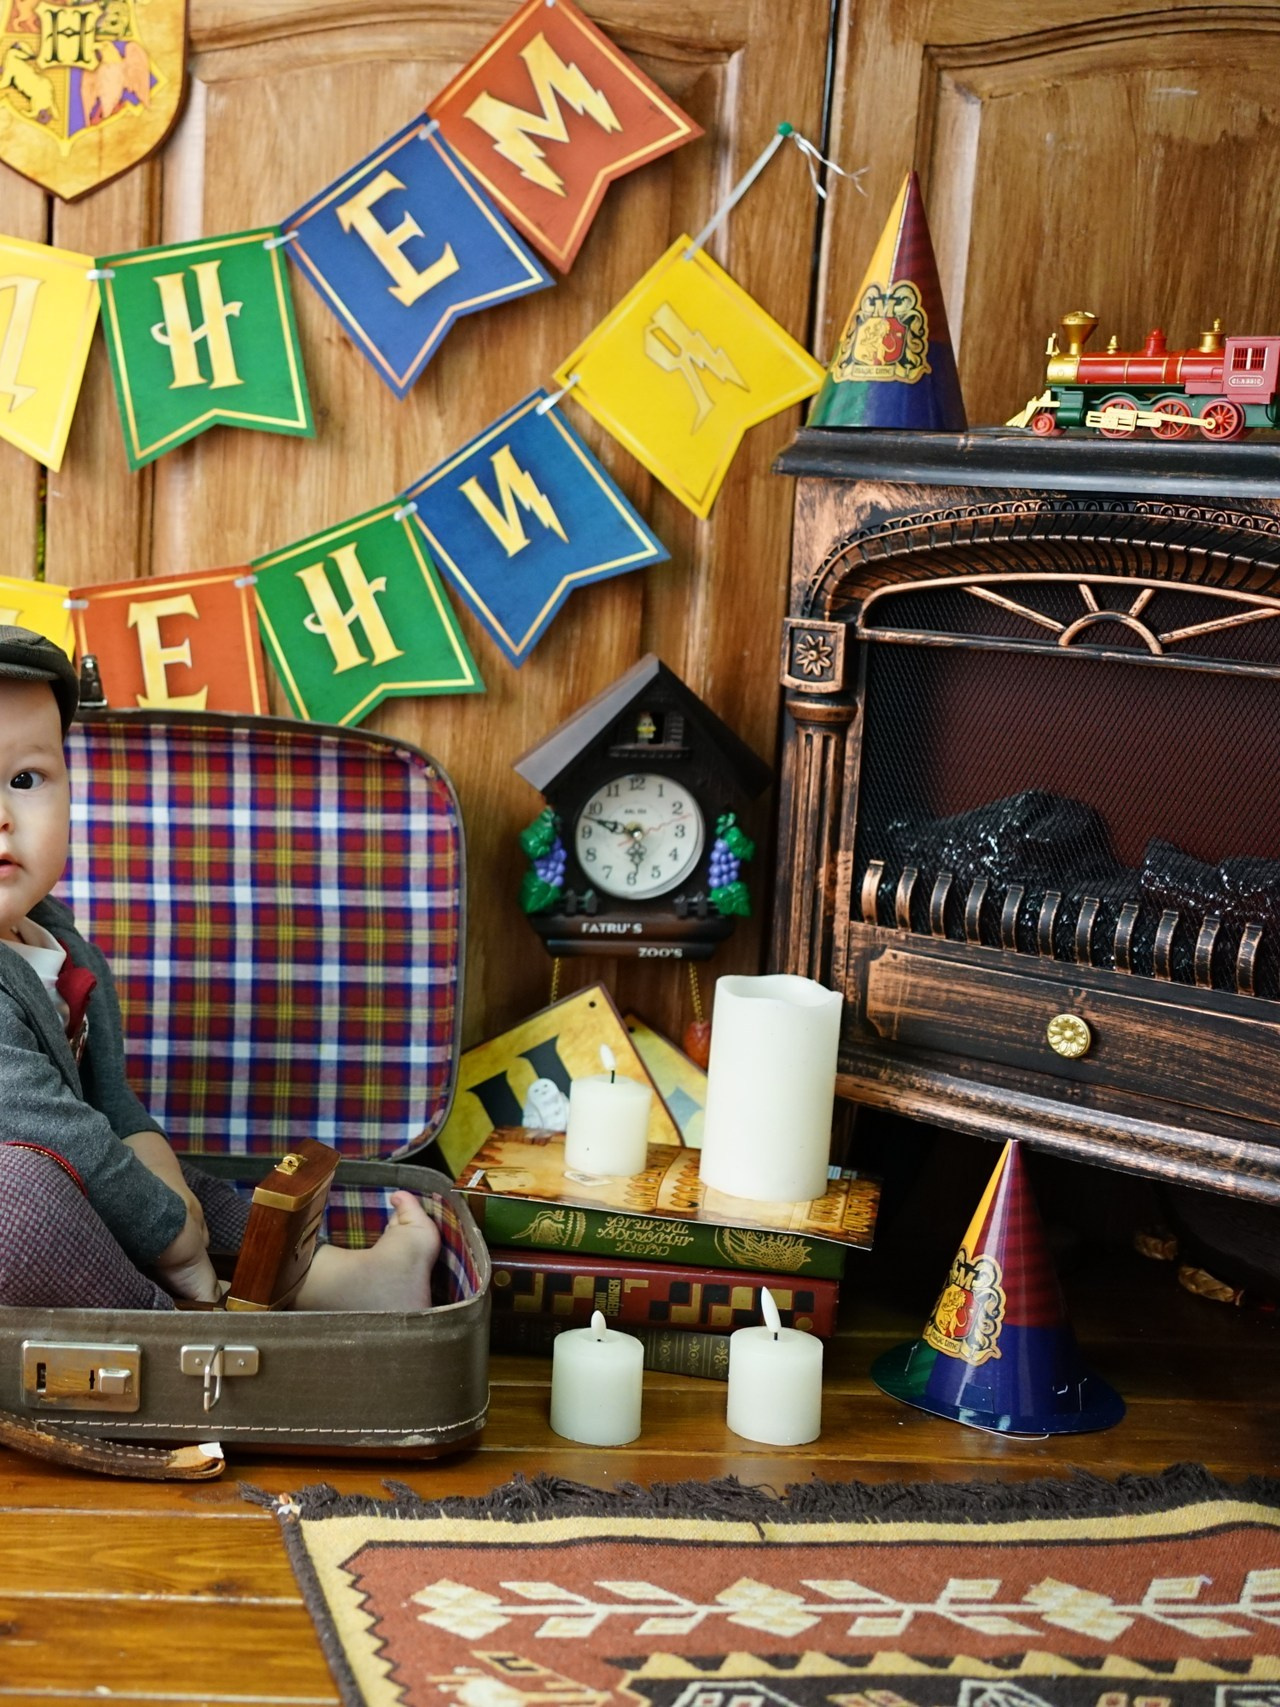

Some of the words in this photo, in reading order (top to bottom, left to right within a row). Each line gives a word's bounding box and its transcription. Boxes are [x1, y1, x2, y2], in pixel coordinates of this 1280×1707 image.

[44, 9, 95, 63] H
[872, 299, 896, 318] M
[629, 776, 646, 790] 12
[606, 784, 621, 797] 11
[657, 784, 665, 797] 1
[588, 802, 603, 815] 10
[672, 802, 684, 815] 2
[582, 825, 593, 839] 9
[675, 825, 686, 838] 3
[585, 848, 597, 862] 8
[668, 848, 679, 861] 4
[602, 867, 613, 880] 7
[626, 872, 637, 886] 6
[651, 866, 661, 879] 5
[638, 946, 683, 958] ZOO'S
[614, 1241, 670, 1256] СКАЗКИ
[954, 1268, 975, 1290] M
